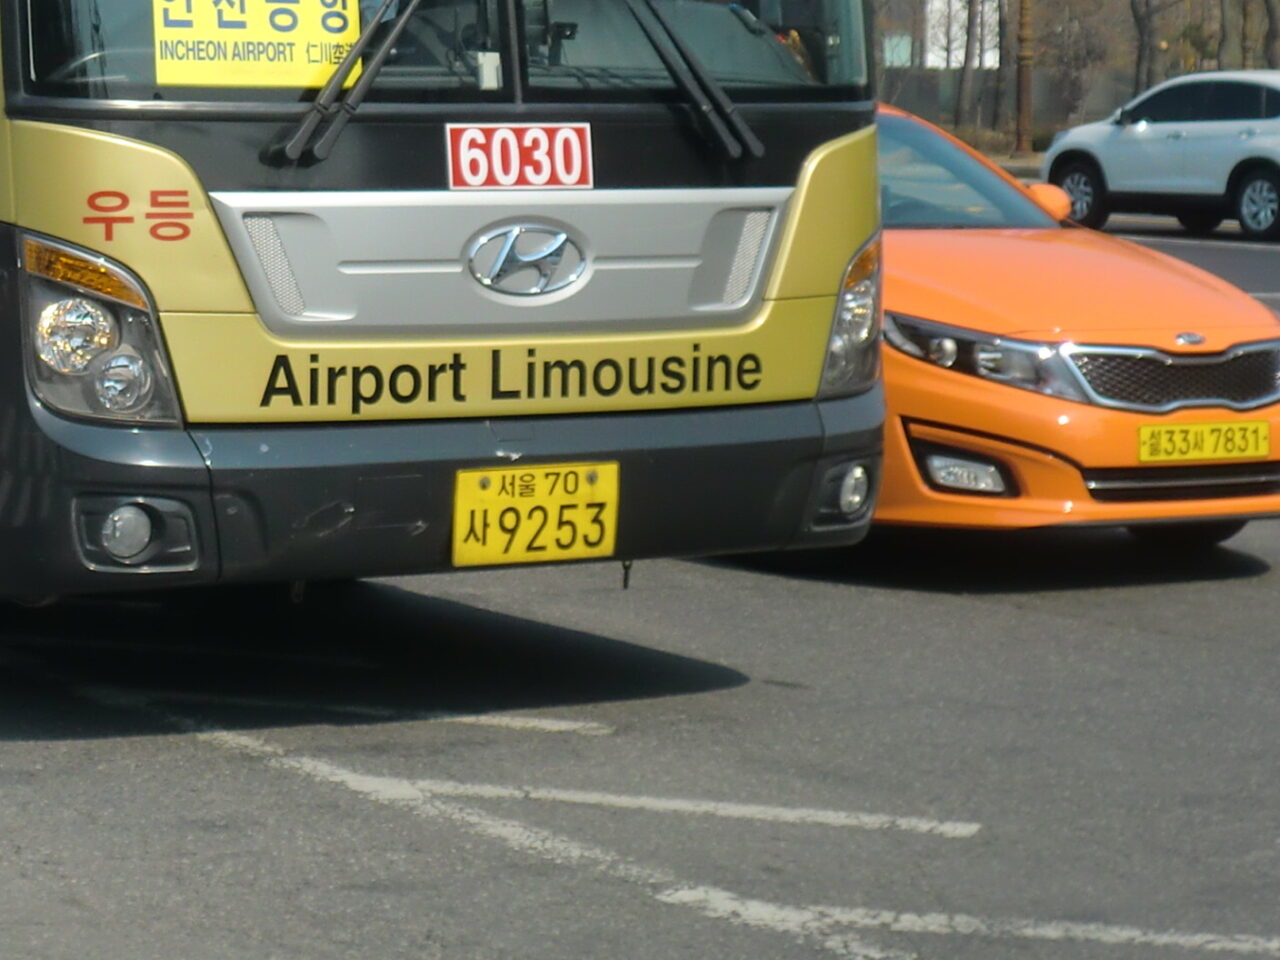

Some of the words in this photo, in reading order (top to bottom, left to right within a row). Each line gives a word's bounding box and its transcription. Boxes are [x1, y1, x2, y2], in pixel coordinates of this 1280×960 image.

[159, 40, 227, 61] INCHEON
[231, 40, 296, 62] AIRPORT
[459, 127, 584, 188] 6030
[82, 189, 195, 242] 우등
[260, 352, 467, 415] Airport
[490, 342, 763, 401] Limousine
[1210, 425, 1260, 454] 7831
[497, 472, 537, 499] 서울
[544, 470, 580, 496] 70
